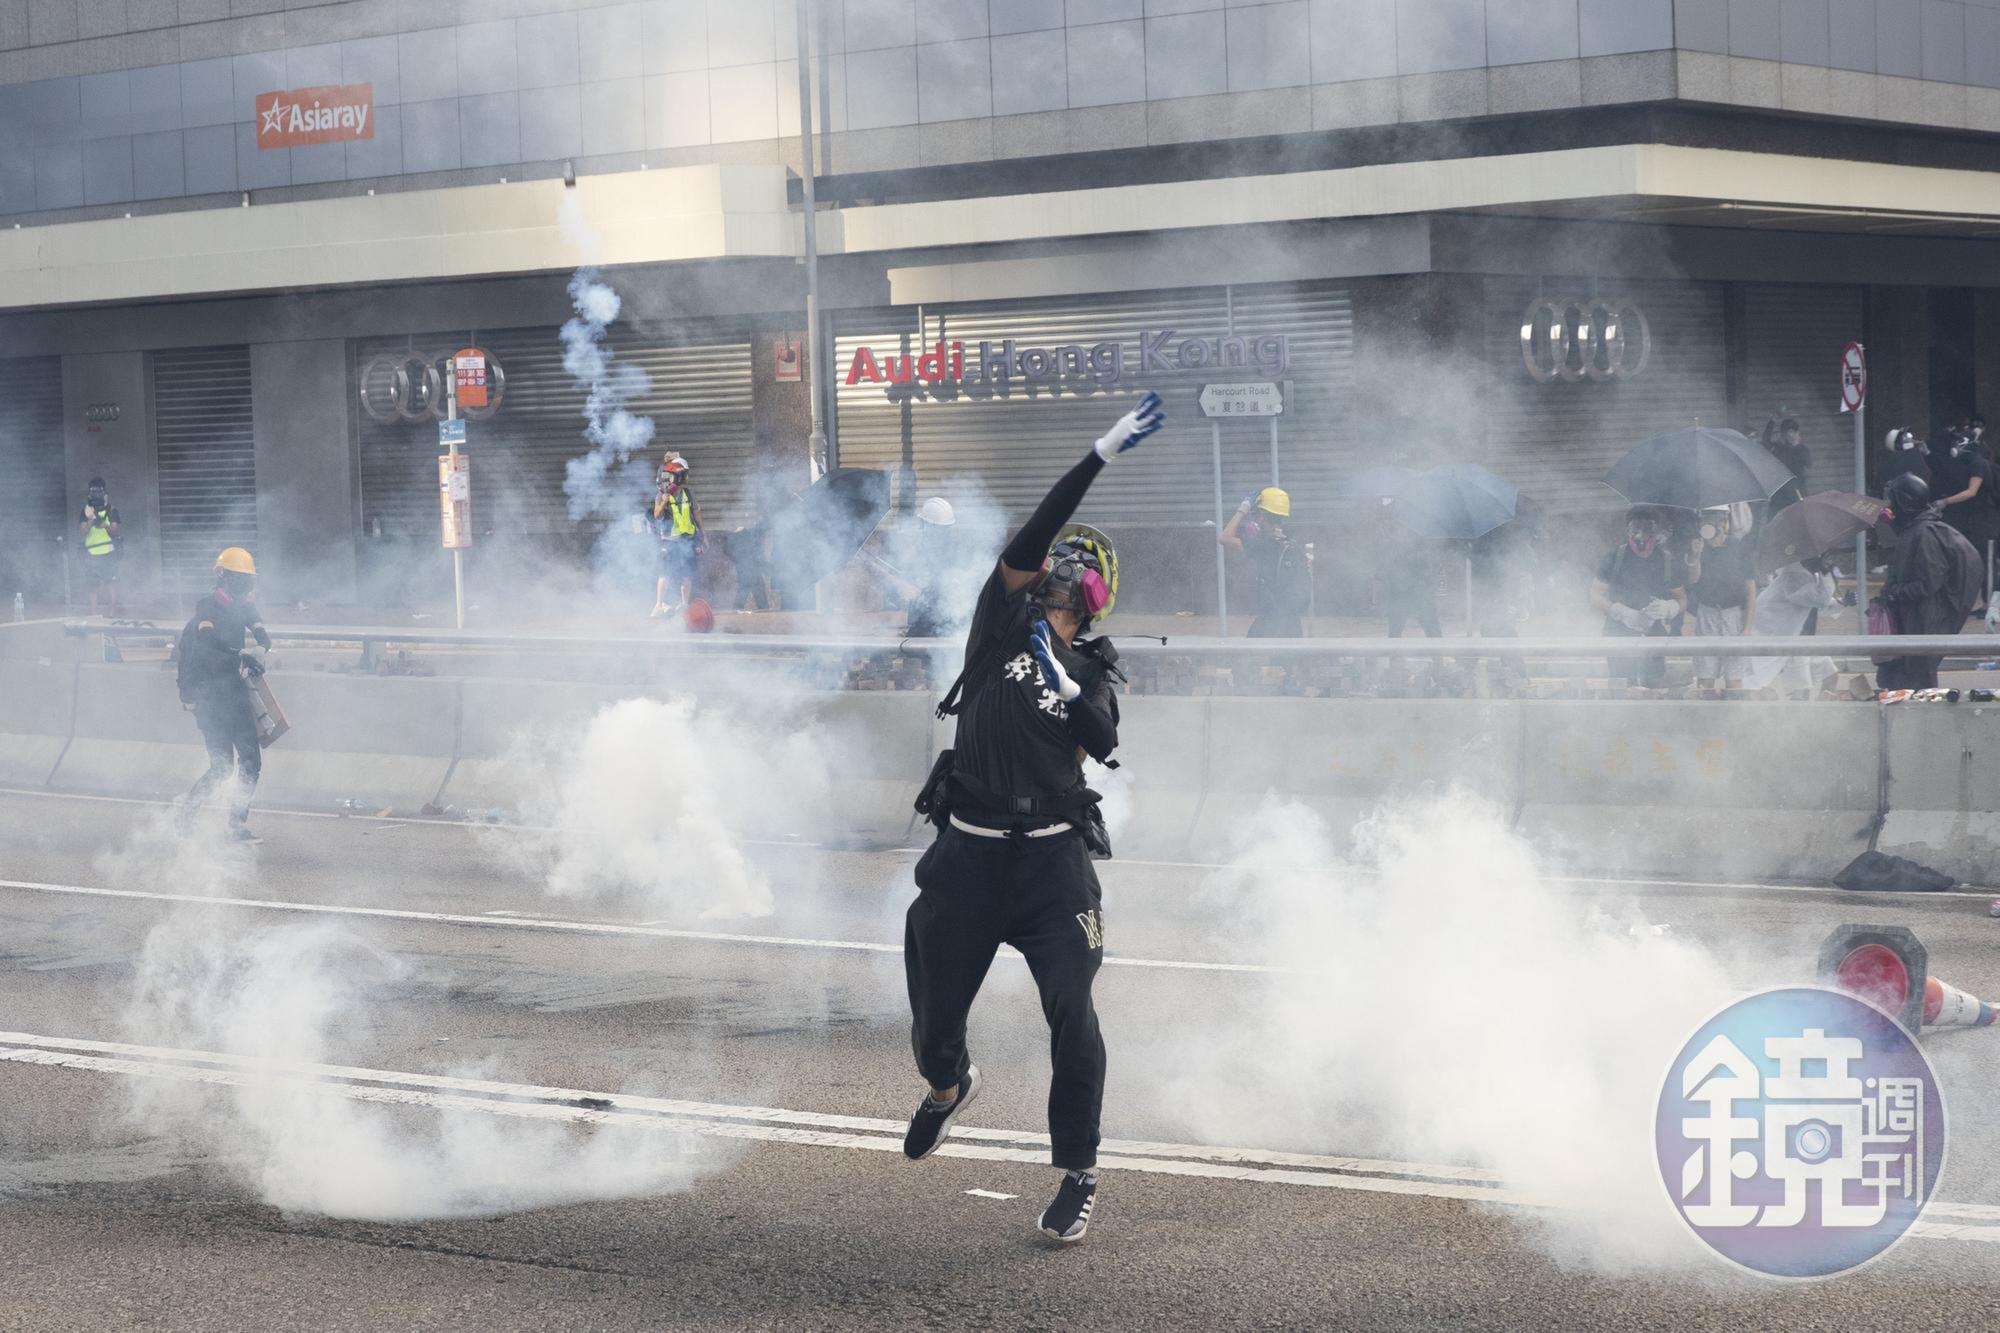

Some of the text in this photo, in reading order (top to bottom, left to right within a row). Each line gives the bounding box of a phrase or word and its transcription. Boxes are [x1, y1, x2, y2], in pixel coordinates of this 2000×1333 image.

[288, 100, 368, 134] Asiaray
[846, 330, 1290, 385] Audi Hong Kong
[1211, 386, 1271, 396] Harcourt Road
